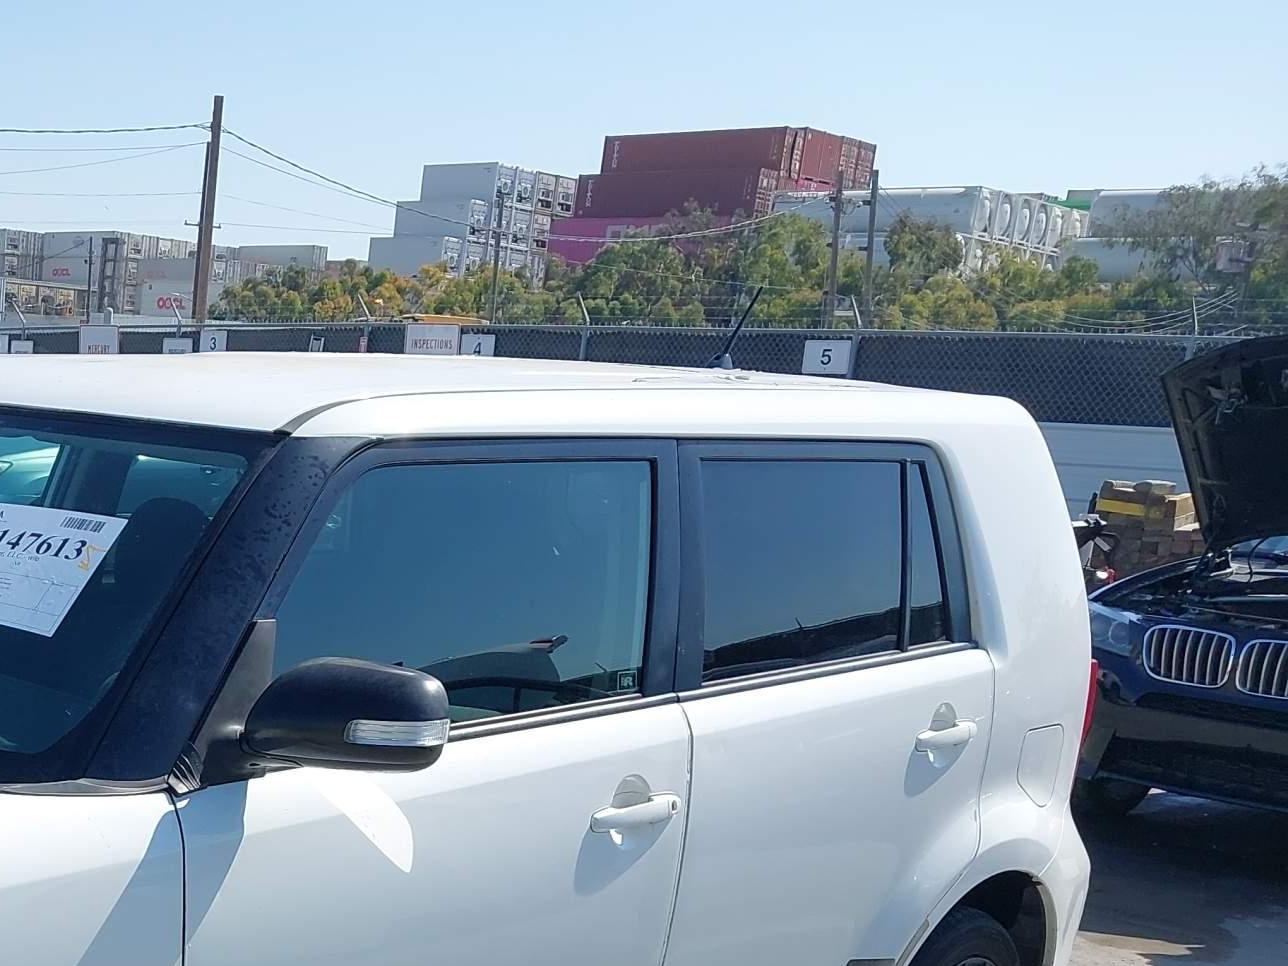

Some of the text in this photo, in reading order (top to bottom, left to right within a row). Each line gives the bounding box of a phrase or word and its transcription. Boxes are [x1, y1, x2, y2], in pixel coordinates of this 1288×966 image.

[209, 336, 217, 350] 3
[411, 338, 453, 350] INSPECTIONS
[473, 342, 482, 356] 4
[820, 348, 833, 366] 5
